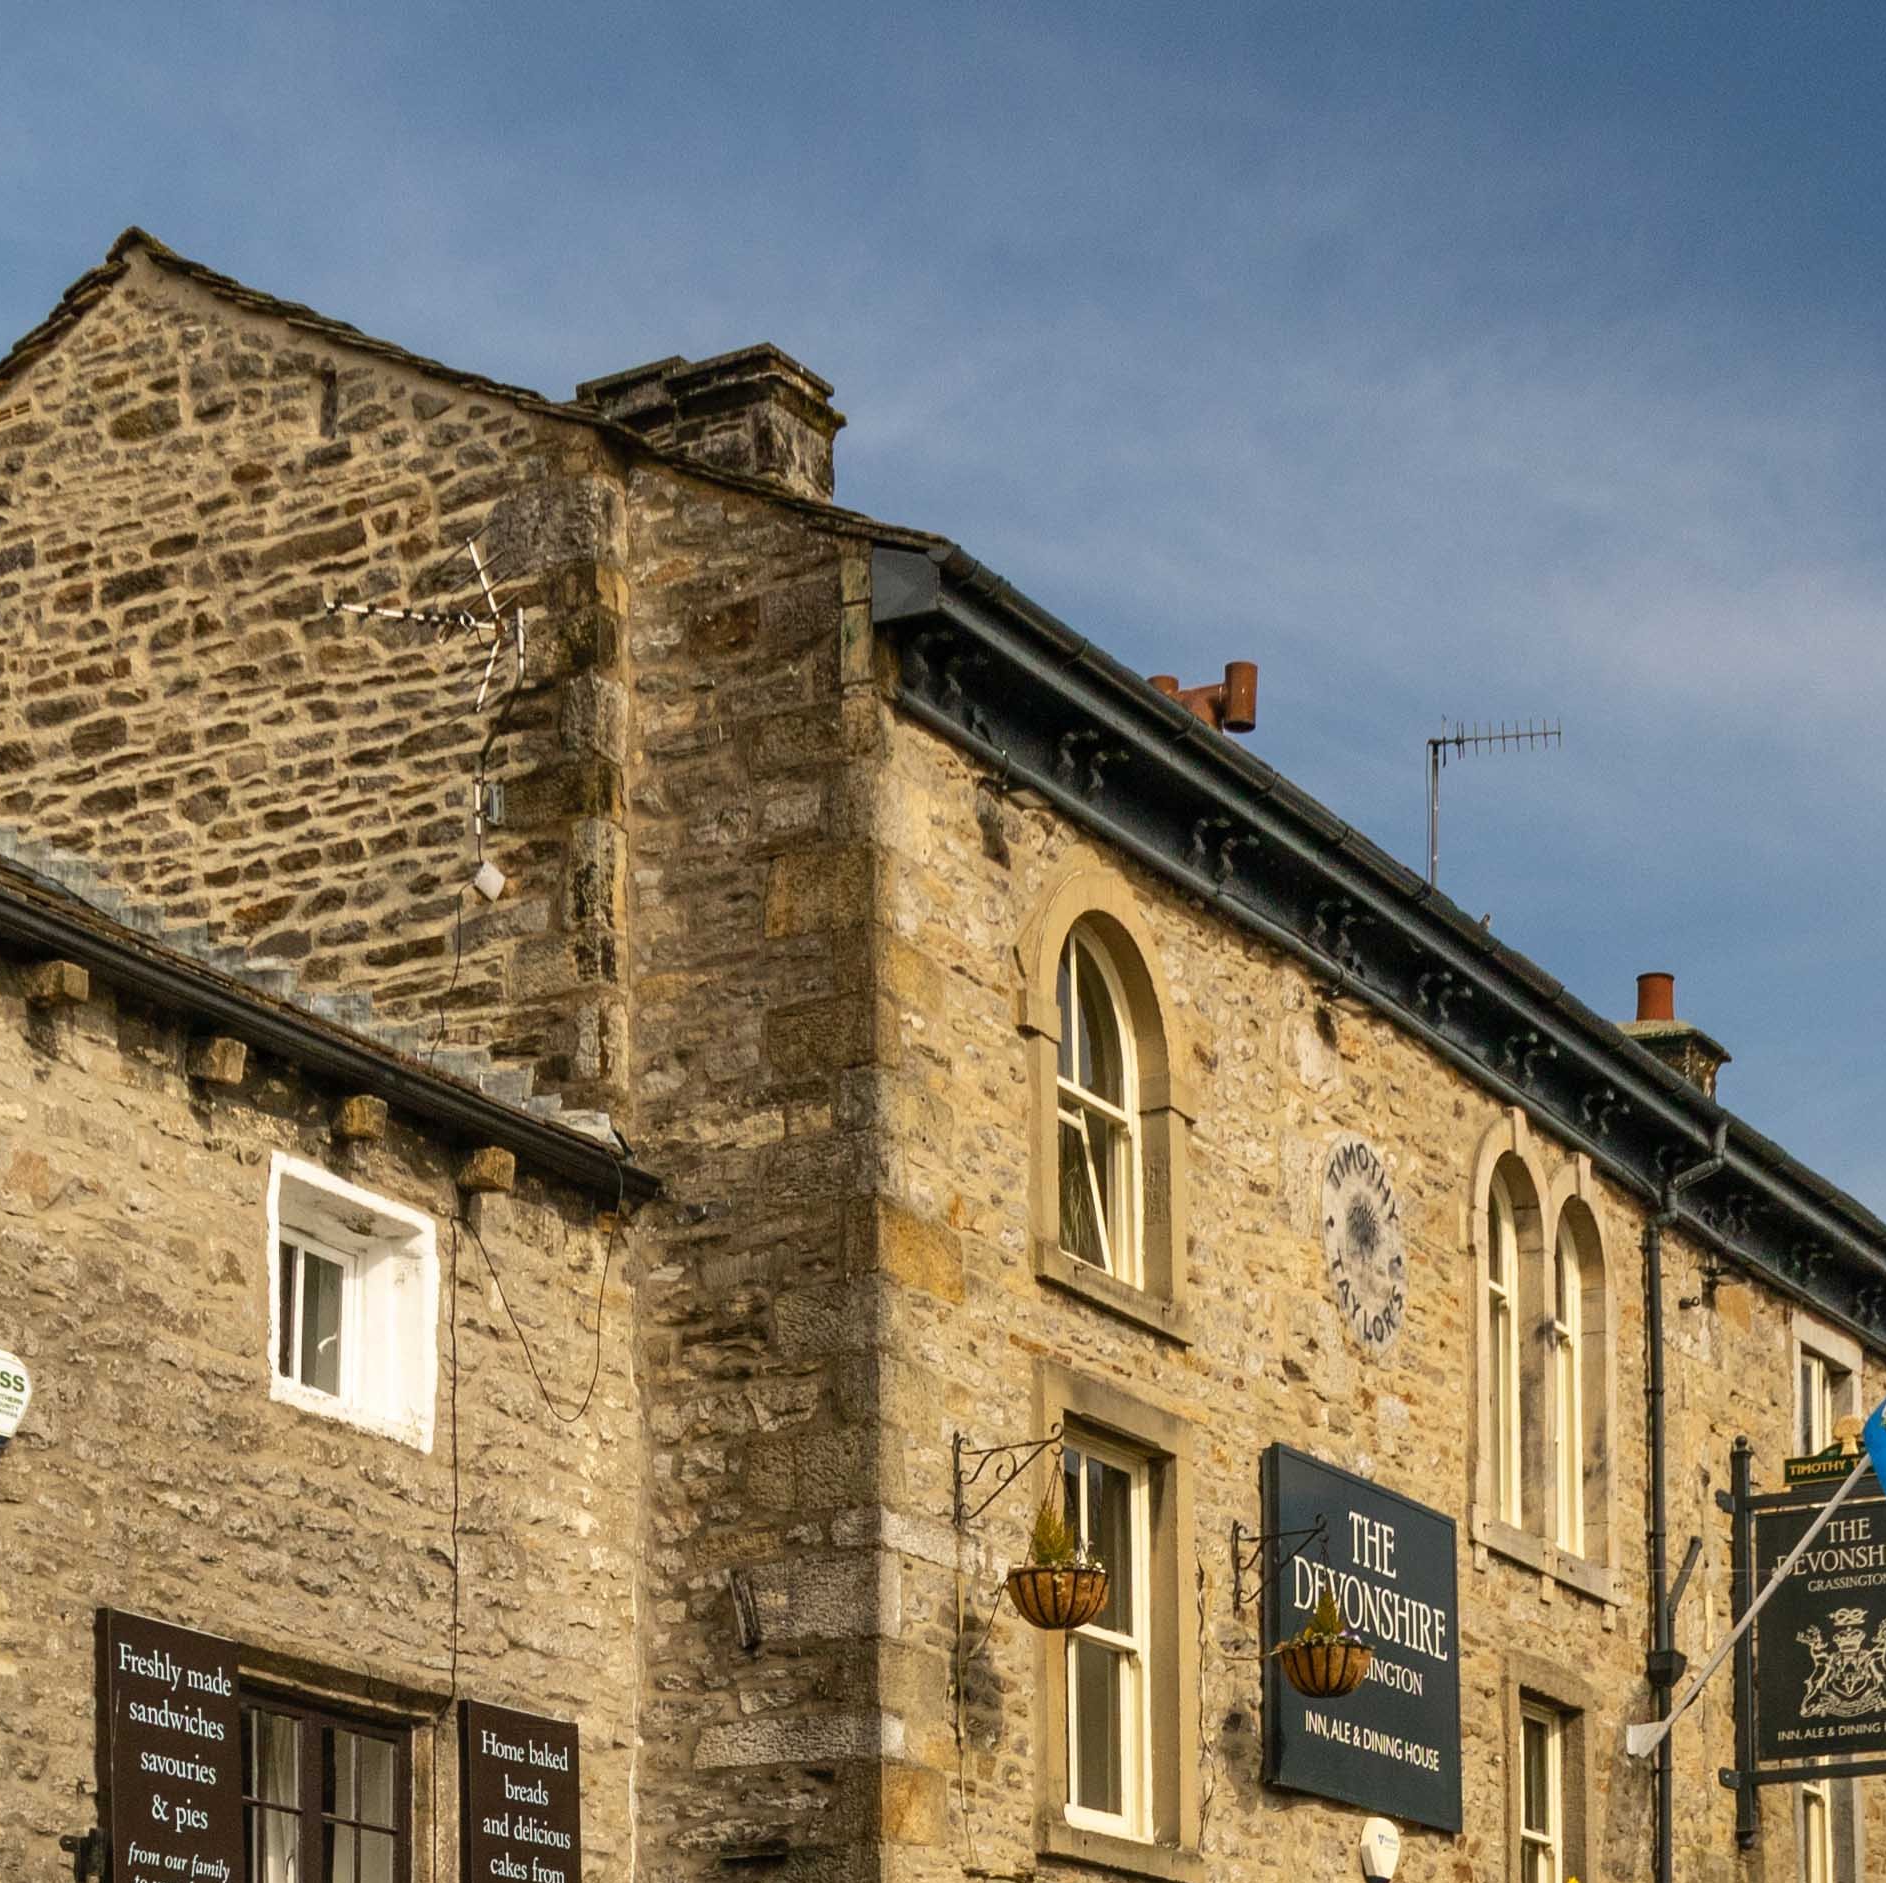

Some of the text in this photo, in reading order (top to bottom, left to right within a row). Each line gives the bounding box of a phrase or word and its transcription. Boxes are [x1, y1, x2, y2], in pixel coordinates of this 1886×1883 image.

[1326, 1141, 1400, 1222] TIMOTHY
[1790, 1459, 1846, 1477] TIMOTHY
[1349, 1511, 1397, 1578] THE
[1826, 1518, 1872, 1543] THE
[1293, 1555, 1448, 1661] DEVONSHIRE
[118, 1642, 232, 1696] Freshly made
[129, 1699, 224, 1741] sandwiches
[1804, 1727, 1825, 1739] ALE
[1827, 1727, 1835, 1737] &
[1838, 1722, 1881, 1736] DINING
[481, 1729, 569, 1772] Home baked
[1305, 1710, 1440, 1772] INN, ALE & DINING HOUSE
[141, 1753, 217, 1785] savouries
[505, 1773, 549, 1806] breads
[152, 1794, 209, 1832] & pies
[483, 1812, 571, 1849] and delicious
[128, 1841, 230, 1883] from our family
[490, 1852, 527, 1880] cakes
